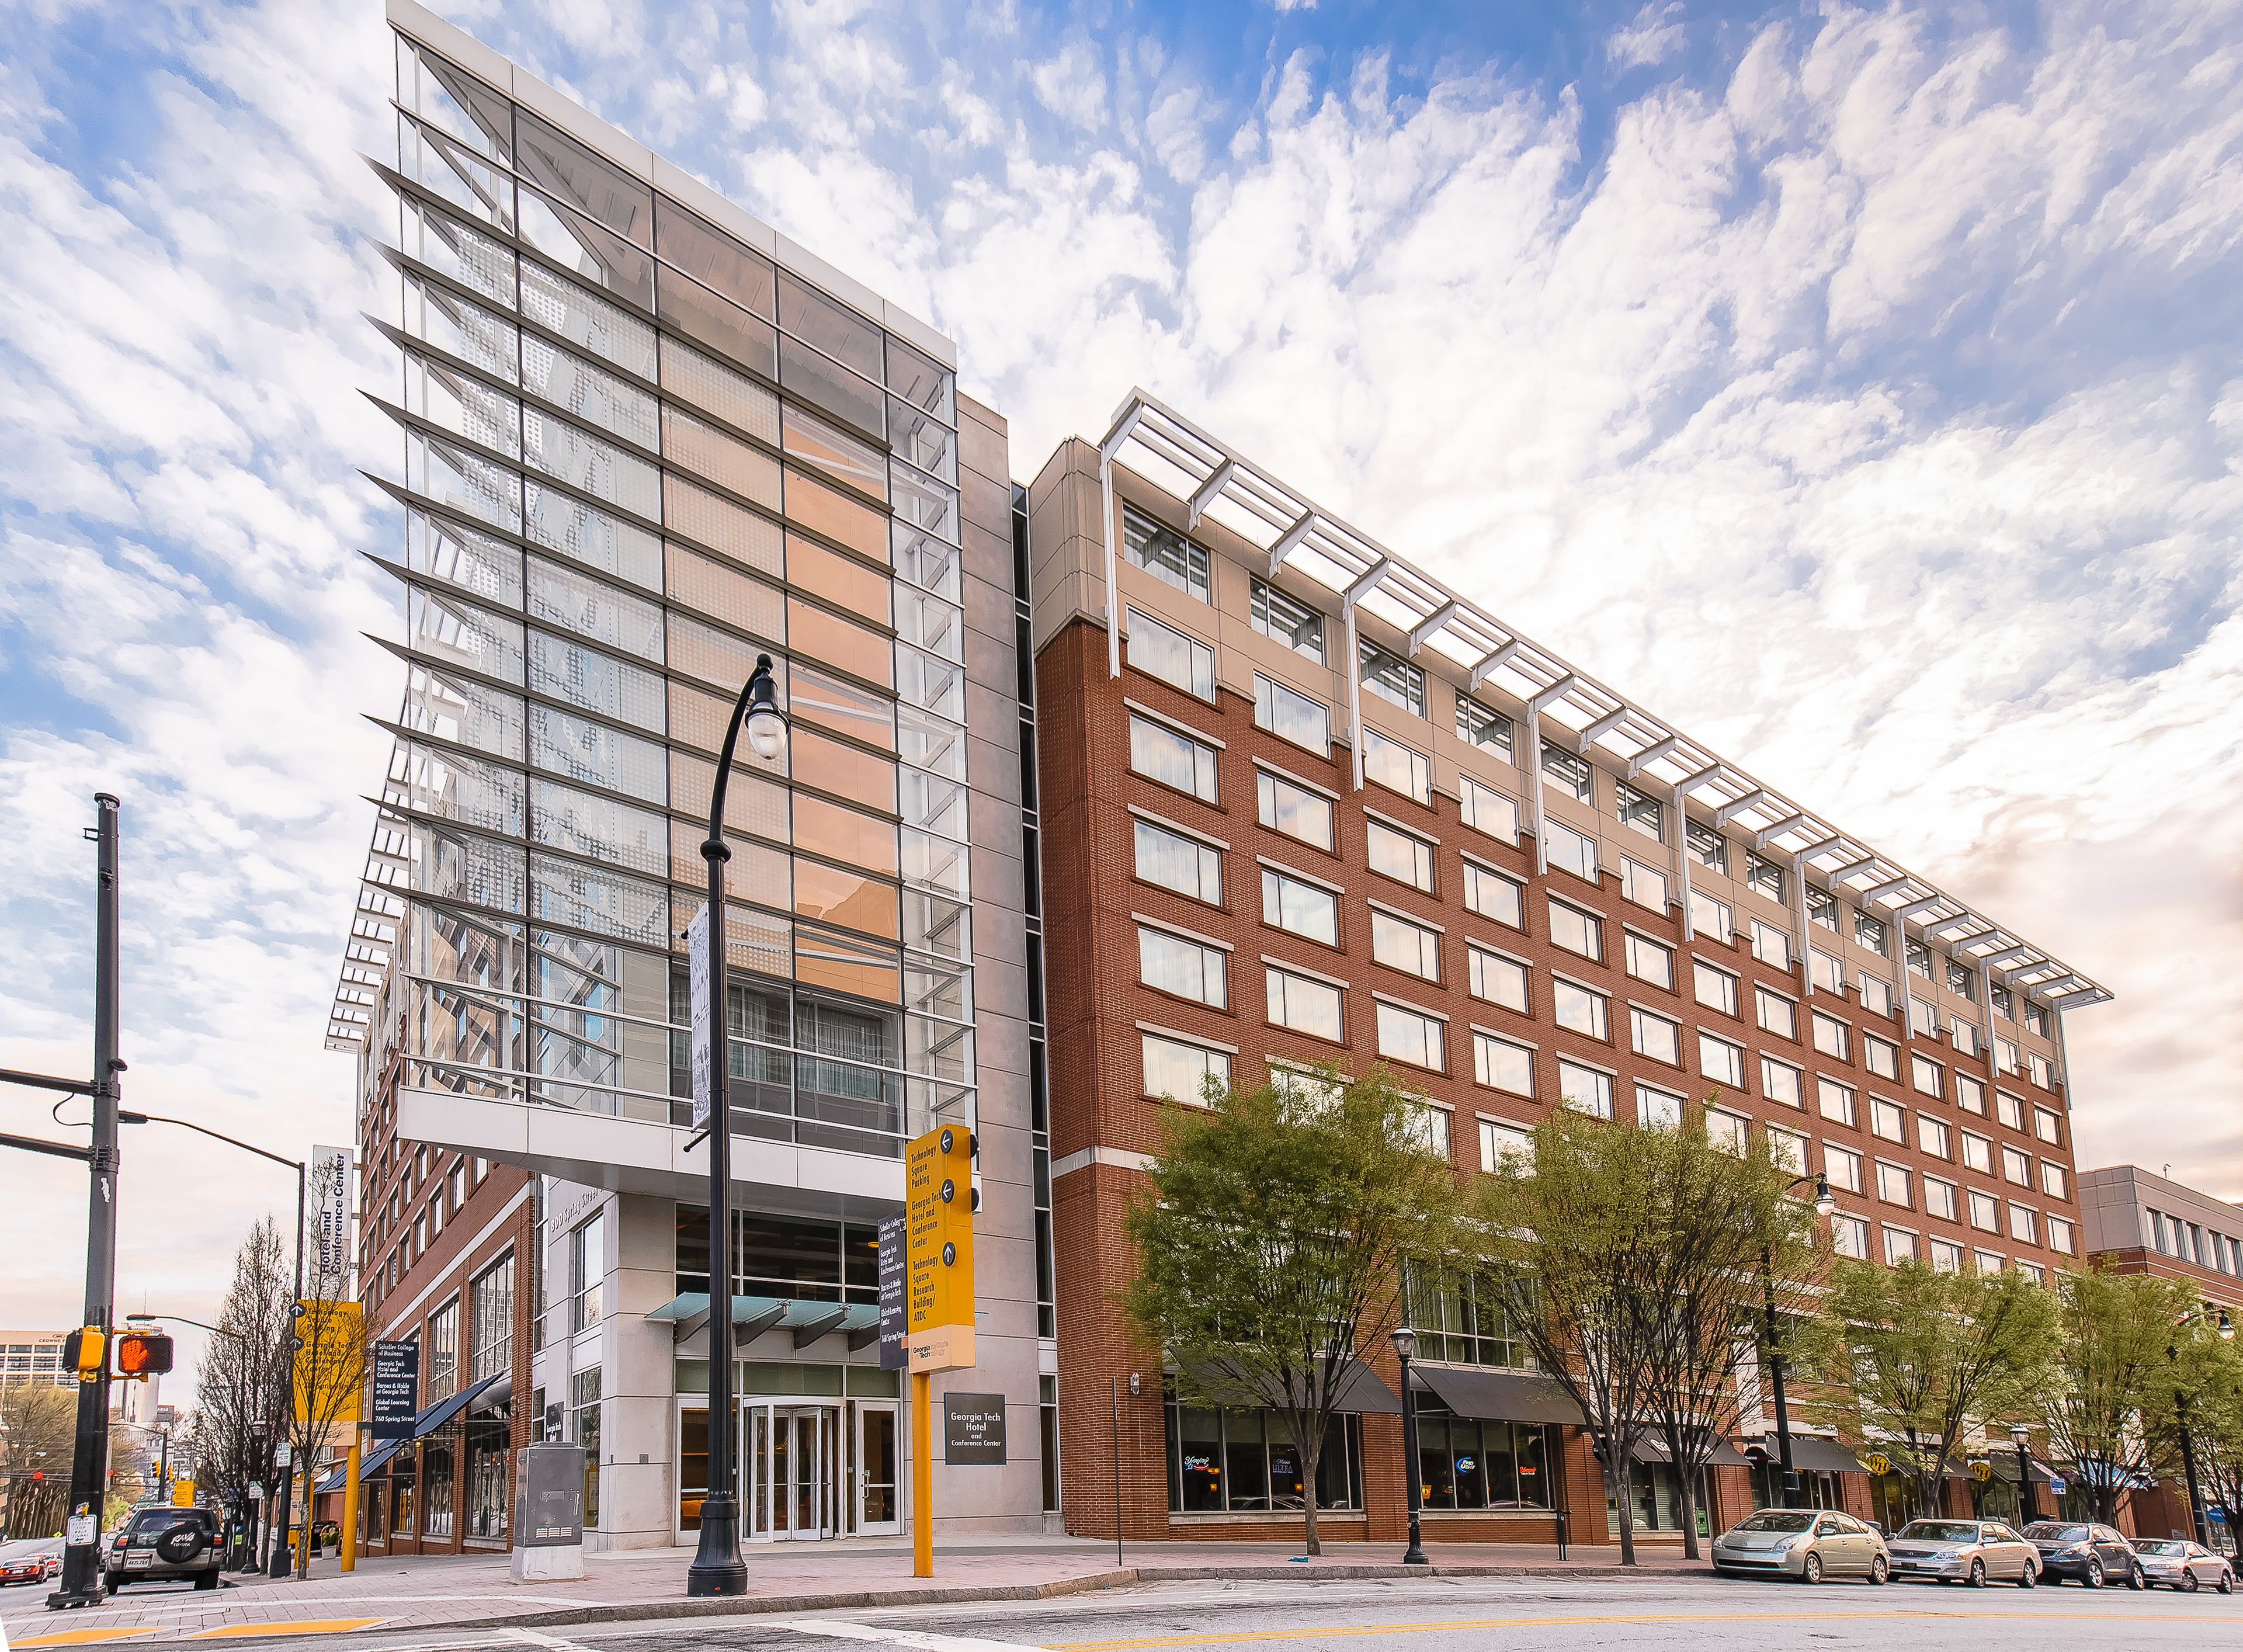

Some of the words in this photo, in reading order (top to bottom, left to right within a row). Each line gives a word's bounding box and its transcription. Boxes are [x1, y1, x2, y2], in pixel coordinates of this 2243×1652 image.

[911, 1146, 936, 1164] Technology
[334, 1153, 345, 1198] Center
[911, 1162, 928, 1178] Square
[911, 1174, 930, 1189] Parking
[911, 1196, 930, 1211] Georgia
[931, 1189, 942, 1202] Tech
[551, 1212, 564, 1233] 800
[564, 1200, 581, 1223] Spring
[581, 1188, 598, 1208] Street
[912, 1208, 925, 1224] Hotel
[926, 1205, 935, 1219] and
[322, 1211, 332, 1236] and
[891, 1218, 900, 1228] Colleg
[912, 1220, 938, 1236] Conference
[331, 1199, 343, 1275] Conference
[883, 1231, 896, 1241] Business
[912, 1237, 928, 1249] Center
[321, 1239, 331, 1273] Hotel
[880, 1248, 891, 1258] Georgia
[880, 1265, 895, 1276] Conference
[895, 1262, 904, 1271] Center
[912, 1255, 939, 1272] Technology
[913, 1272, 929, 1285] Square
[884, 1290, 895, 1300] Georgia
[913, 1280, 935, 1297] Research
[914, 1293, 936, 1309] Building/
[308, 1309, 348, 1317] Tehnology
[890, 1306, 902, 1315] Learning
[914, 1310, 926, 1322] ATDC
[307, 1324, 335, 1332] Paing
[881, 1318, 890, 1327] Center
[887, 1332, 897, 1343] Spring
[306, 1341, 334, 1349] Gorgia
[913, 1344, 930, 1353] Georgia
[950, 1412, 982, 1422] Georgia
[984, 1412, 1001, 1421] Tech
[966, 1422, 987, 1431] Hotel
[170, 1532, 196, 1546] RAV4
